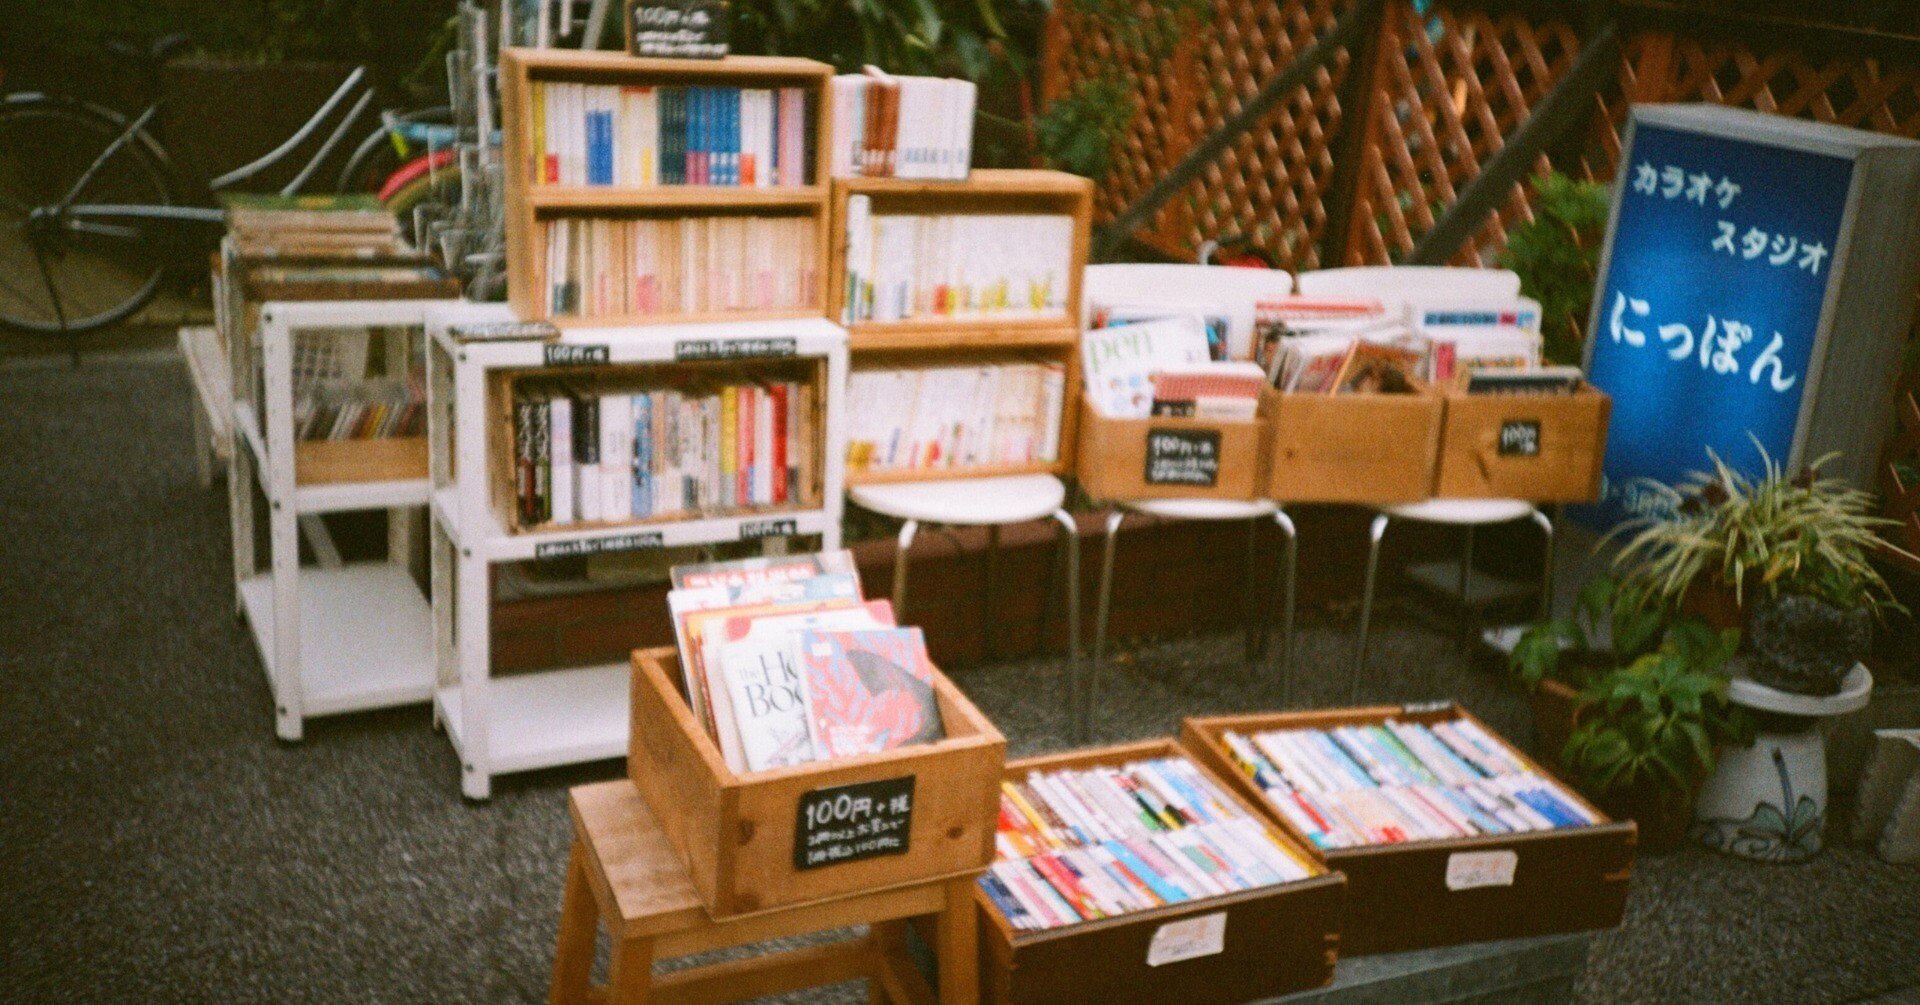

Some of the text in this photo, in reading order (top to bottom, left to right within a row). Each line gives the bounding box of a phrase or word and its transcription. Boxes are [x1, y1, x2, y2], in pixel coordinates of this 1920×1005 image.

[1633, 161, 1742, 209] カラオケ
[1711, 221, 1829, 275] スタジオ
[1609, 290, 1797, 393] にっぽん
